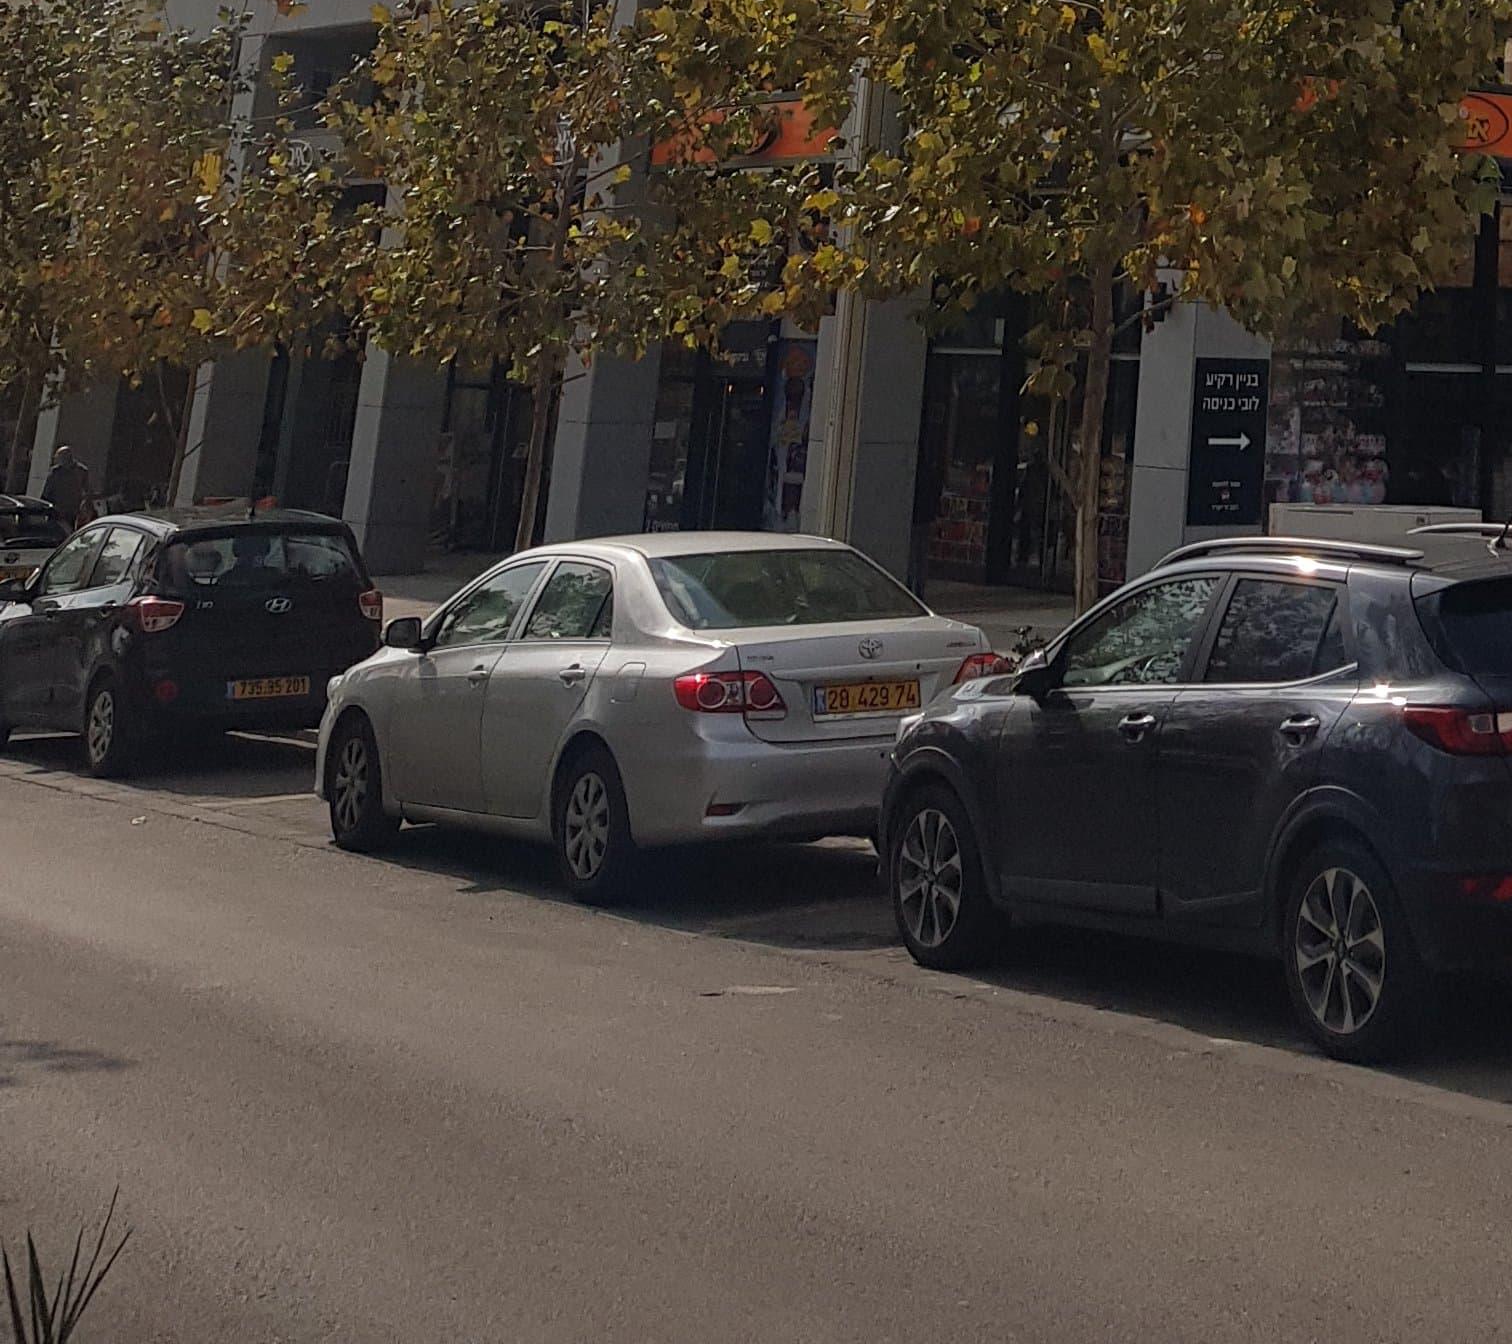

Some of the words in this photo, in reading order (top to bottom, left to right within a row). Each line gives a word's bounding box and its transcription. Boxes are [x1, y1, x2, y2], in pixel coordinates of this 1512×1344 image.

[1205, 372, 1233, 390] רקיע
[1235, 373, 1259, 391] בניין
[1202, 396, 1236, 411] כניסה
[1238, 395, 1261, 411] לובי
